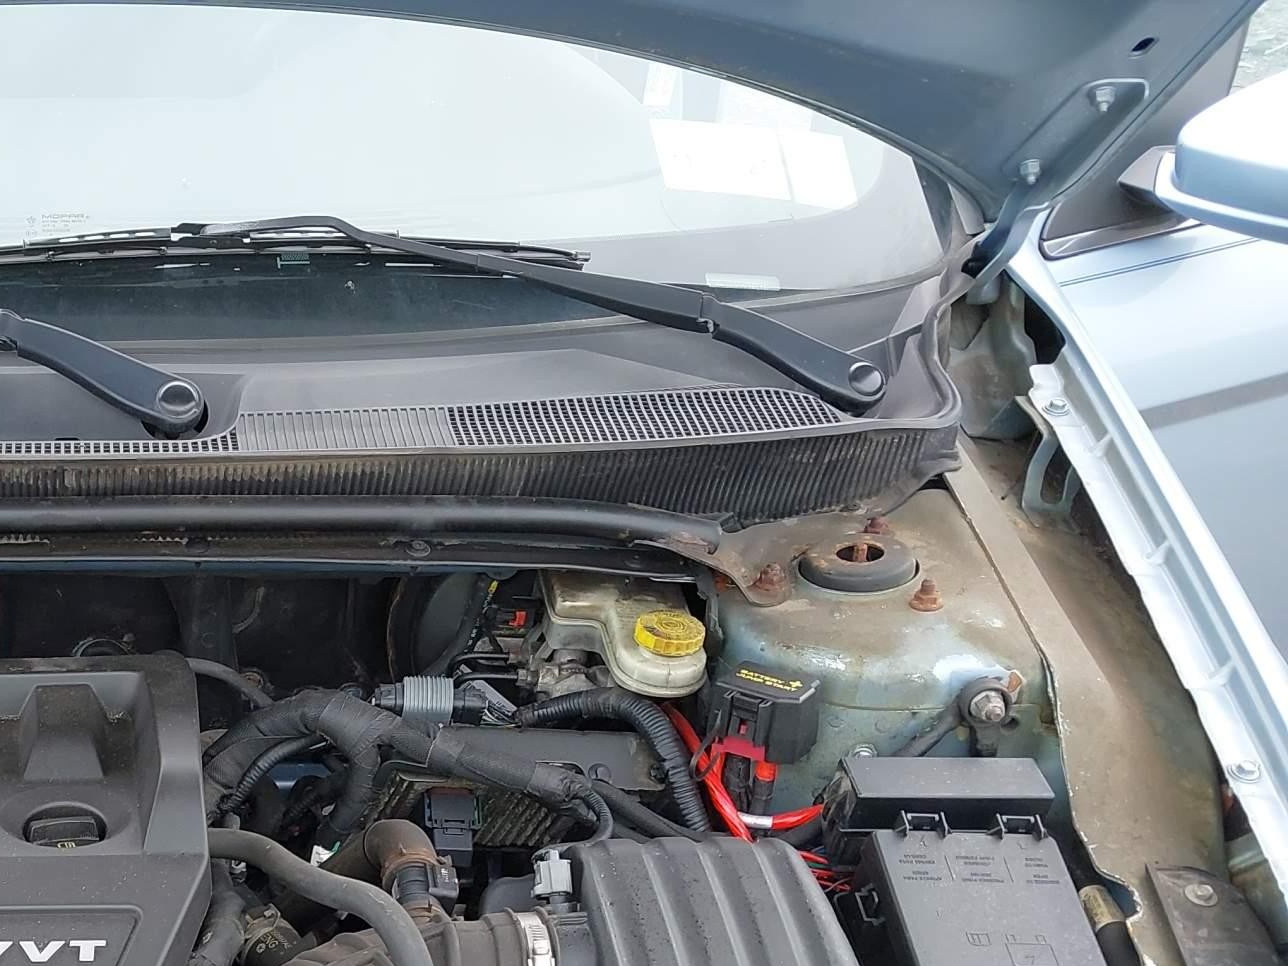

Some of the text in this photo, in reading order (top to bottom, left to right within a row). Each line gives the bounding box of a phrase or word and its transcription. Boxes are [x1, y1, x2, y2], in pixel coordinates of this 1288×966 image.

[735, 672, 799, 691] JUMP START
[740, 669, 784, 683] BATTERY
